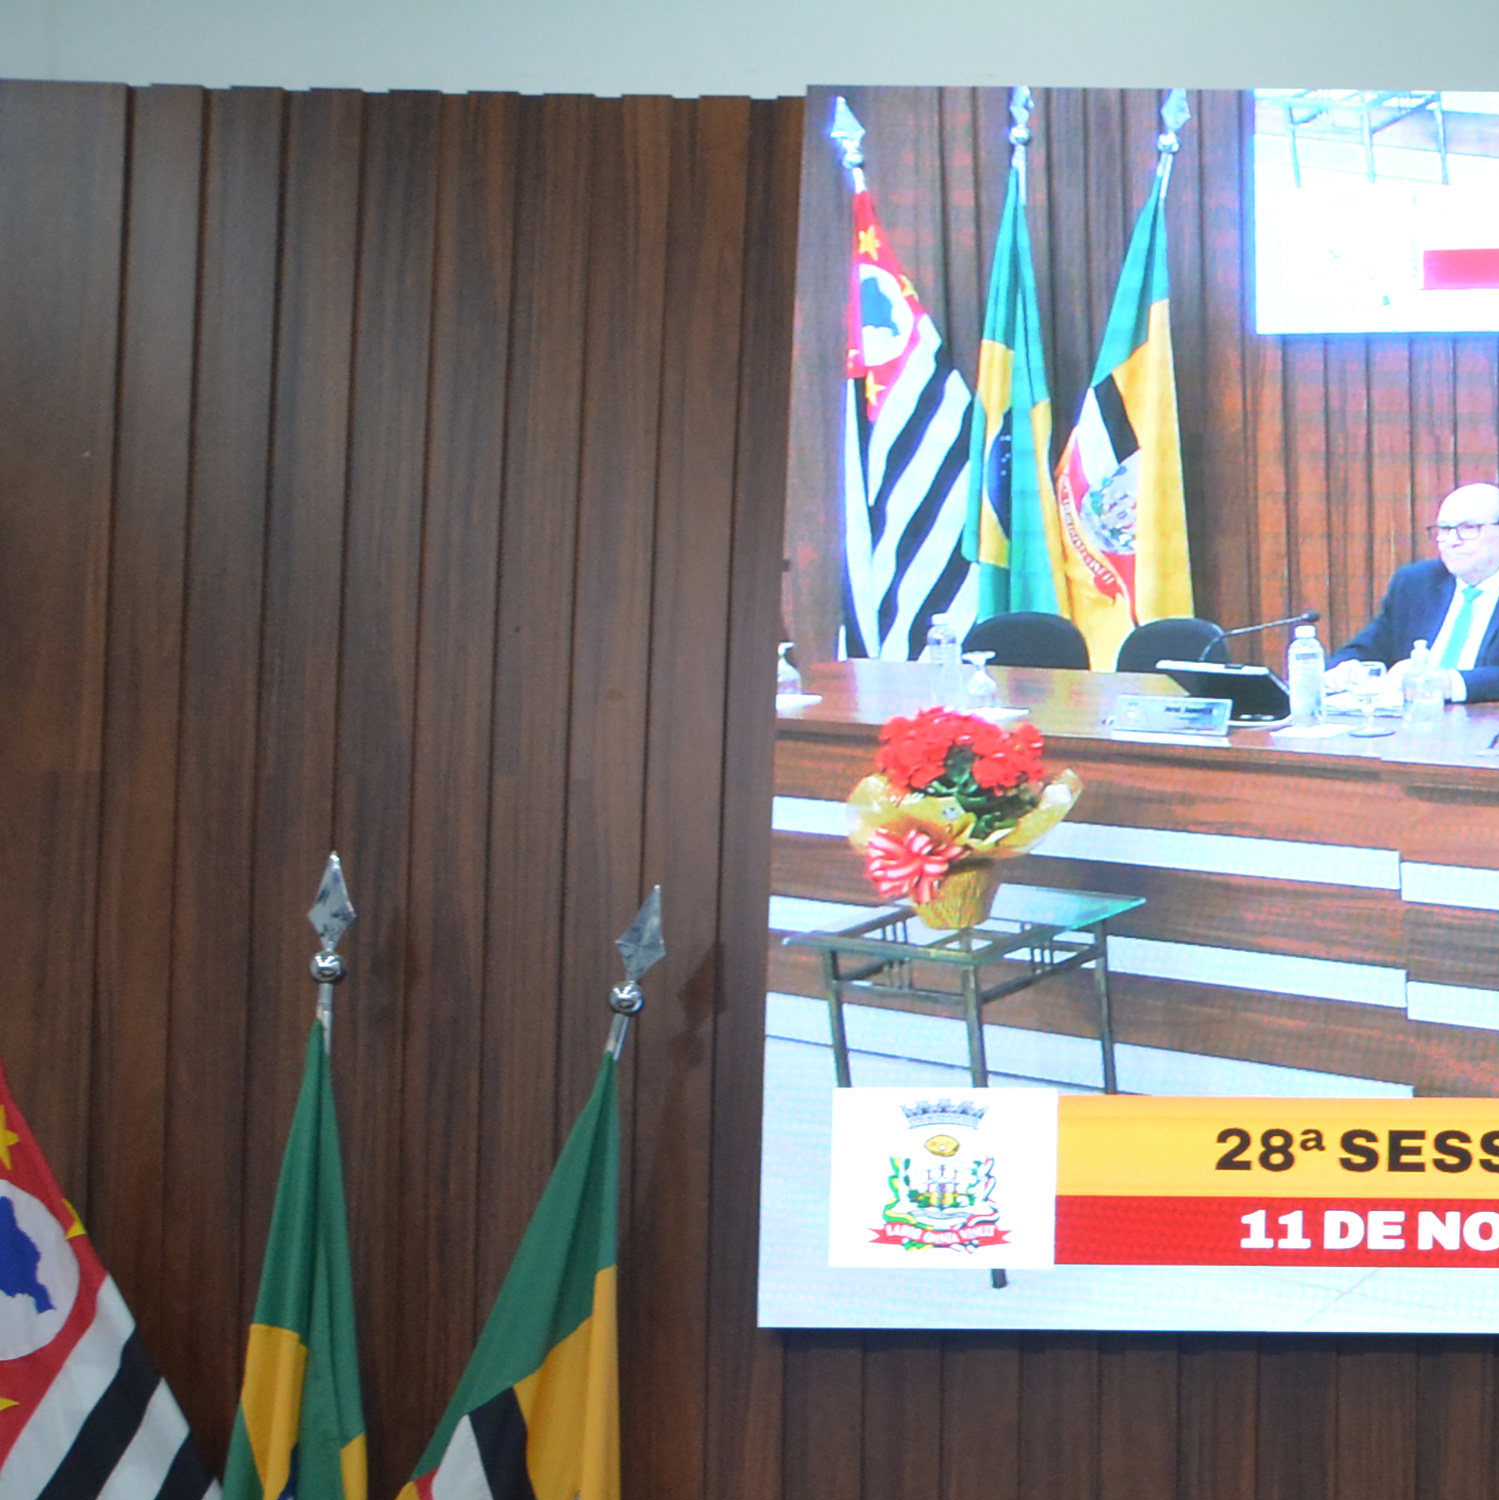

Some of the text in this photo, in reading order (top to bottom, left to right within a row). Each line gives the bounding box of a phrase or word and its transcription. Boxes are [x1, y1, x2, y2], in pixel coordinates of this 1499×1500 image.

[1215, 1127, 1326, 1172] 28ª
[1240, 1209, 1311, 1250] 11
[1323, 1211, 1405, 1251] DE
